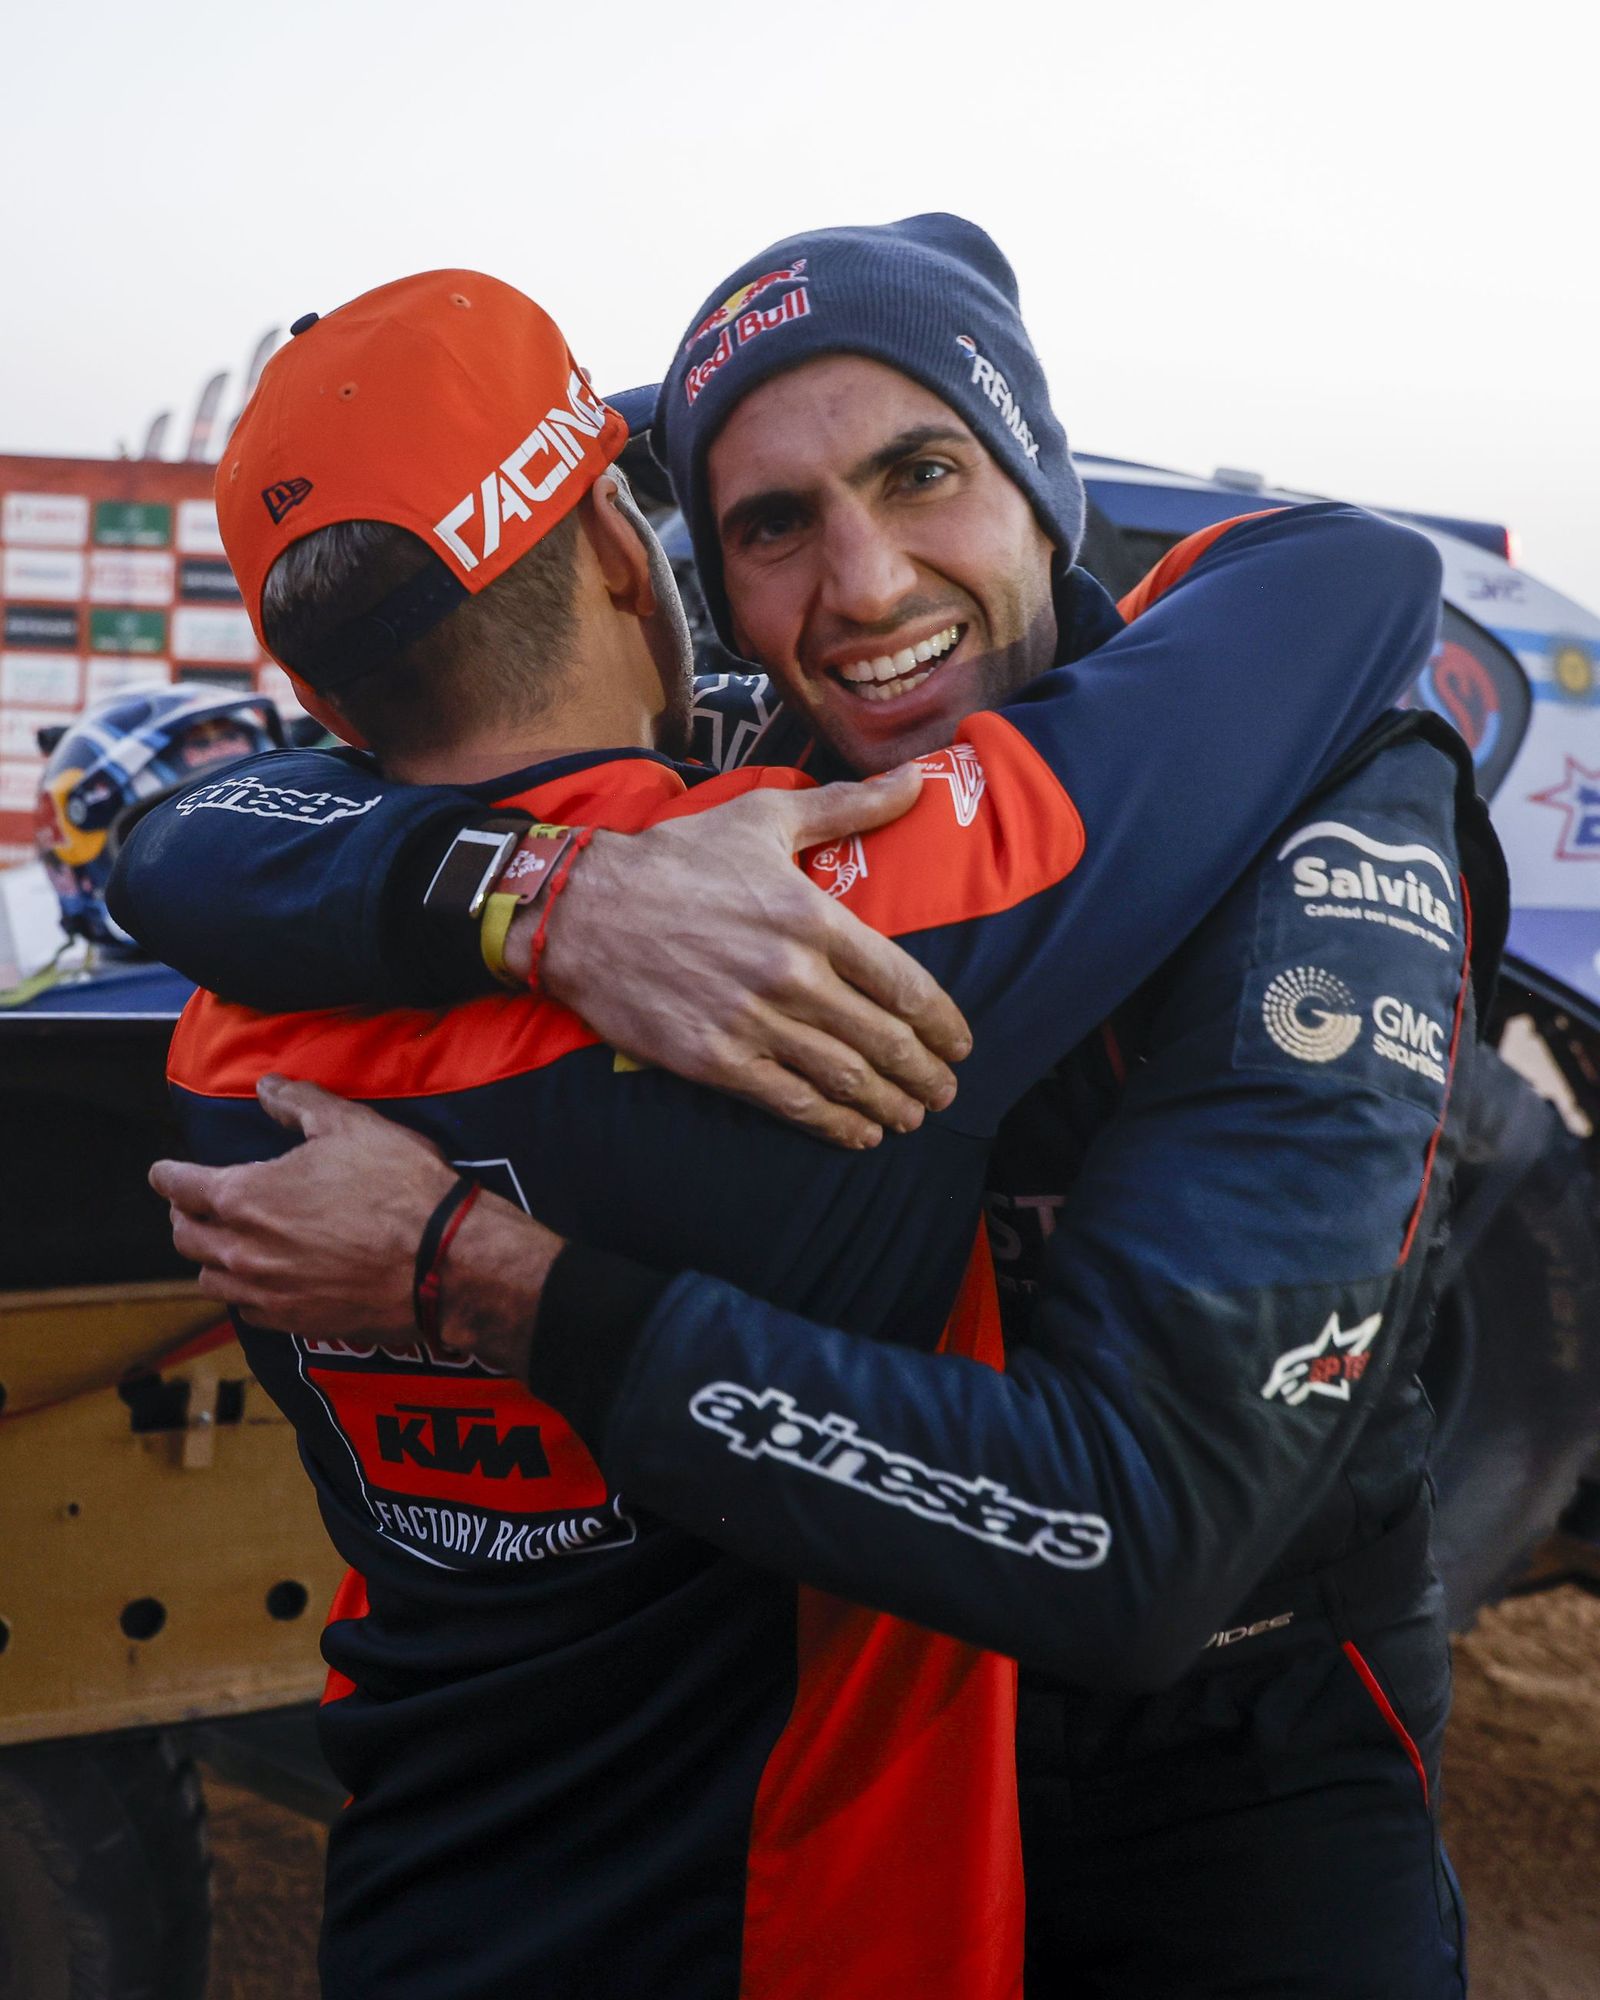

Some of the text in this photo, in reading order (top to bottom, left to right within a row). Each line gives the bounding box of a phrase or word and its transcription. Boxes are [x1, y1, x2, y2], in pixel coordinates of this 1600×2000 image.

[684, 287, 810, 406] Red Bull
[1293, 856, 1456, 936] Salvita
[1373, 995, 1444, 1062] GMC
[376, 1403, 552, 1480] KTM
[375, 1500, 487, 1555] FACTORY
